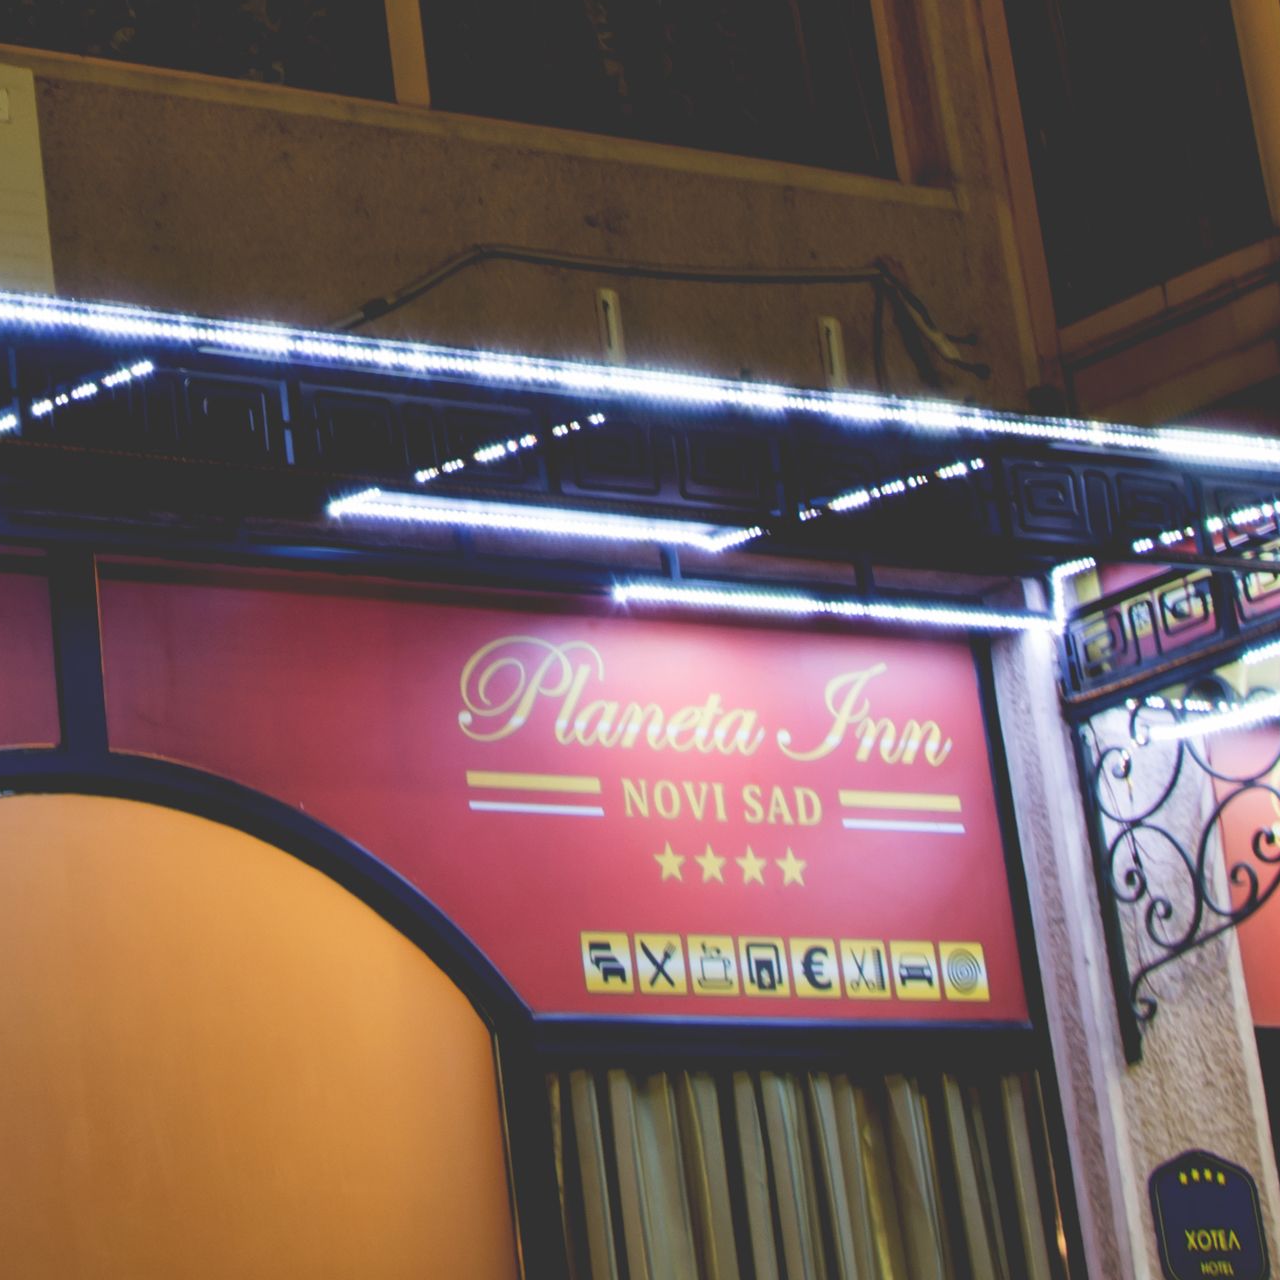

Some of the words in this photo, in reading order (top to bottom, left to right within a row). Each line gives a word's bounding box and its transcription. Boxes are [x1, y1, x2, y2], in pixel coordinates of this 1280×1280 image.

[458, 635, 765, 757] Planeta
[776, 662, 953, 767] Inn
[621, 776, 728, 824] NOVI
[742, 783, 823, 826] SAD
